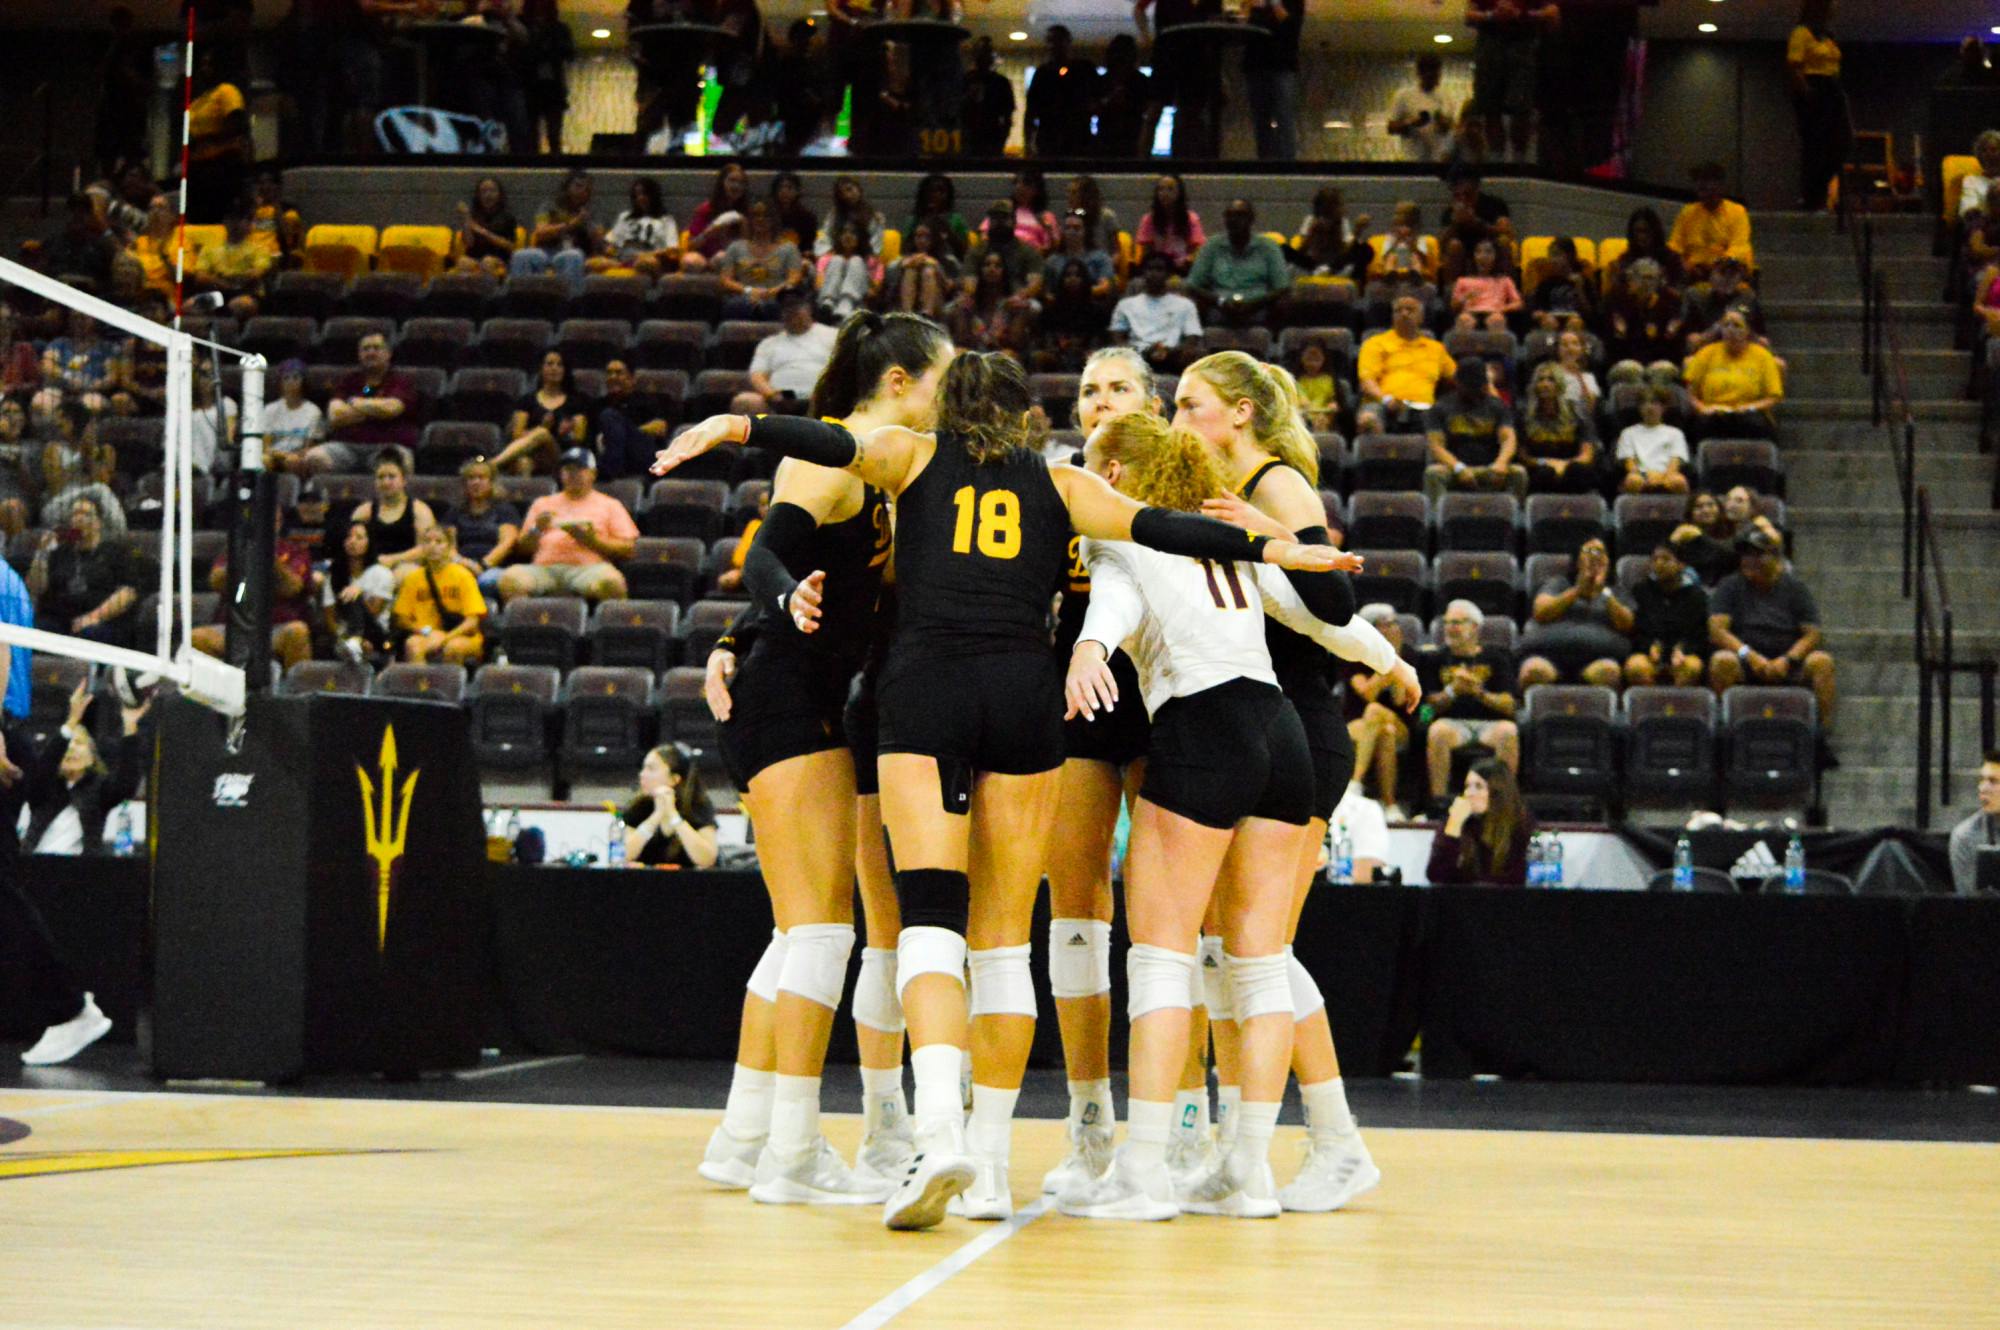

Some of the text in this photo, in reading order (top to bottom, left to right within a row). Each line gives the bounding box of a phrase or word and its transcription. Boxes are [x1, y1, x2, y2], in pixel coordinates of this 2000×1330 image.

[919, 129, 961, 154] 101
[952, 485, 1022, 559] 18
[1195, 557, 1249, 609] 11
